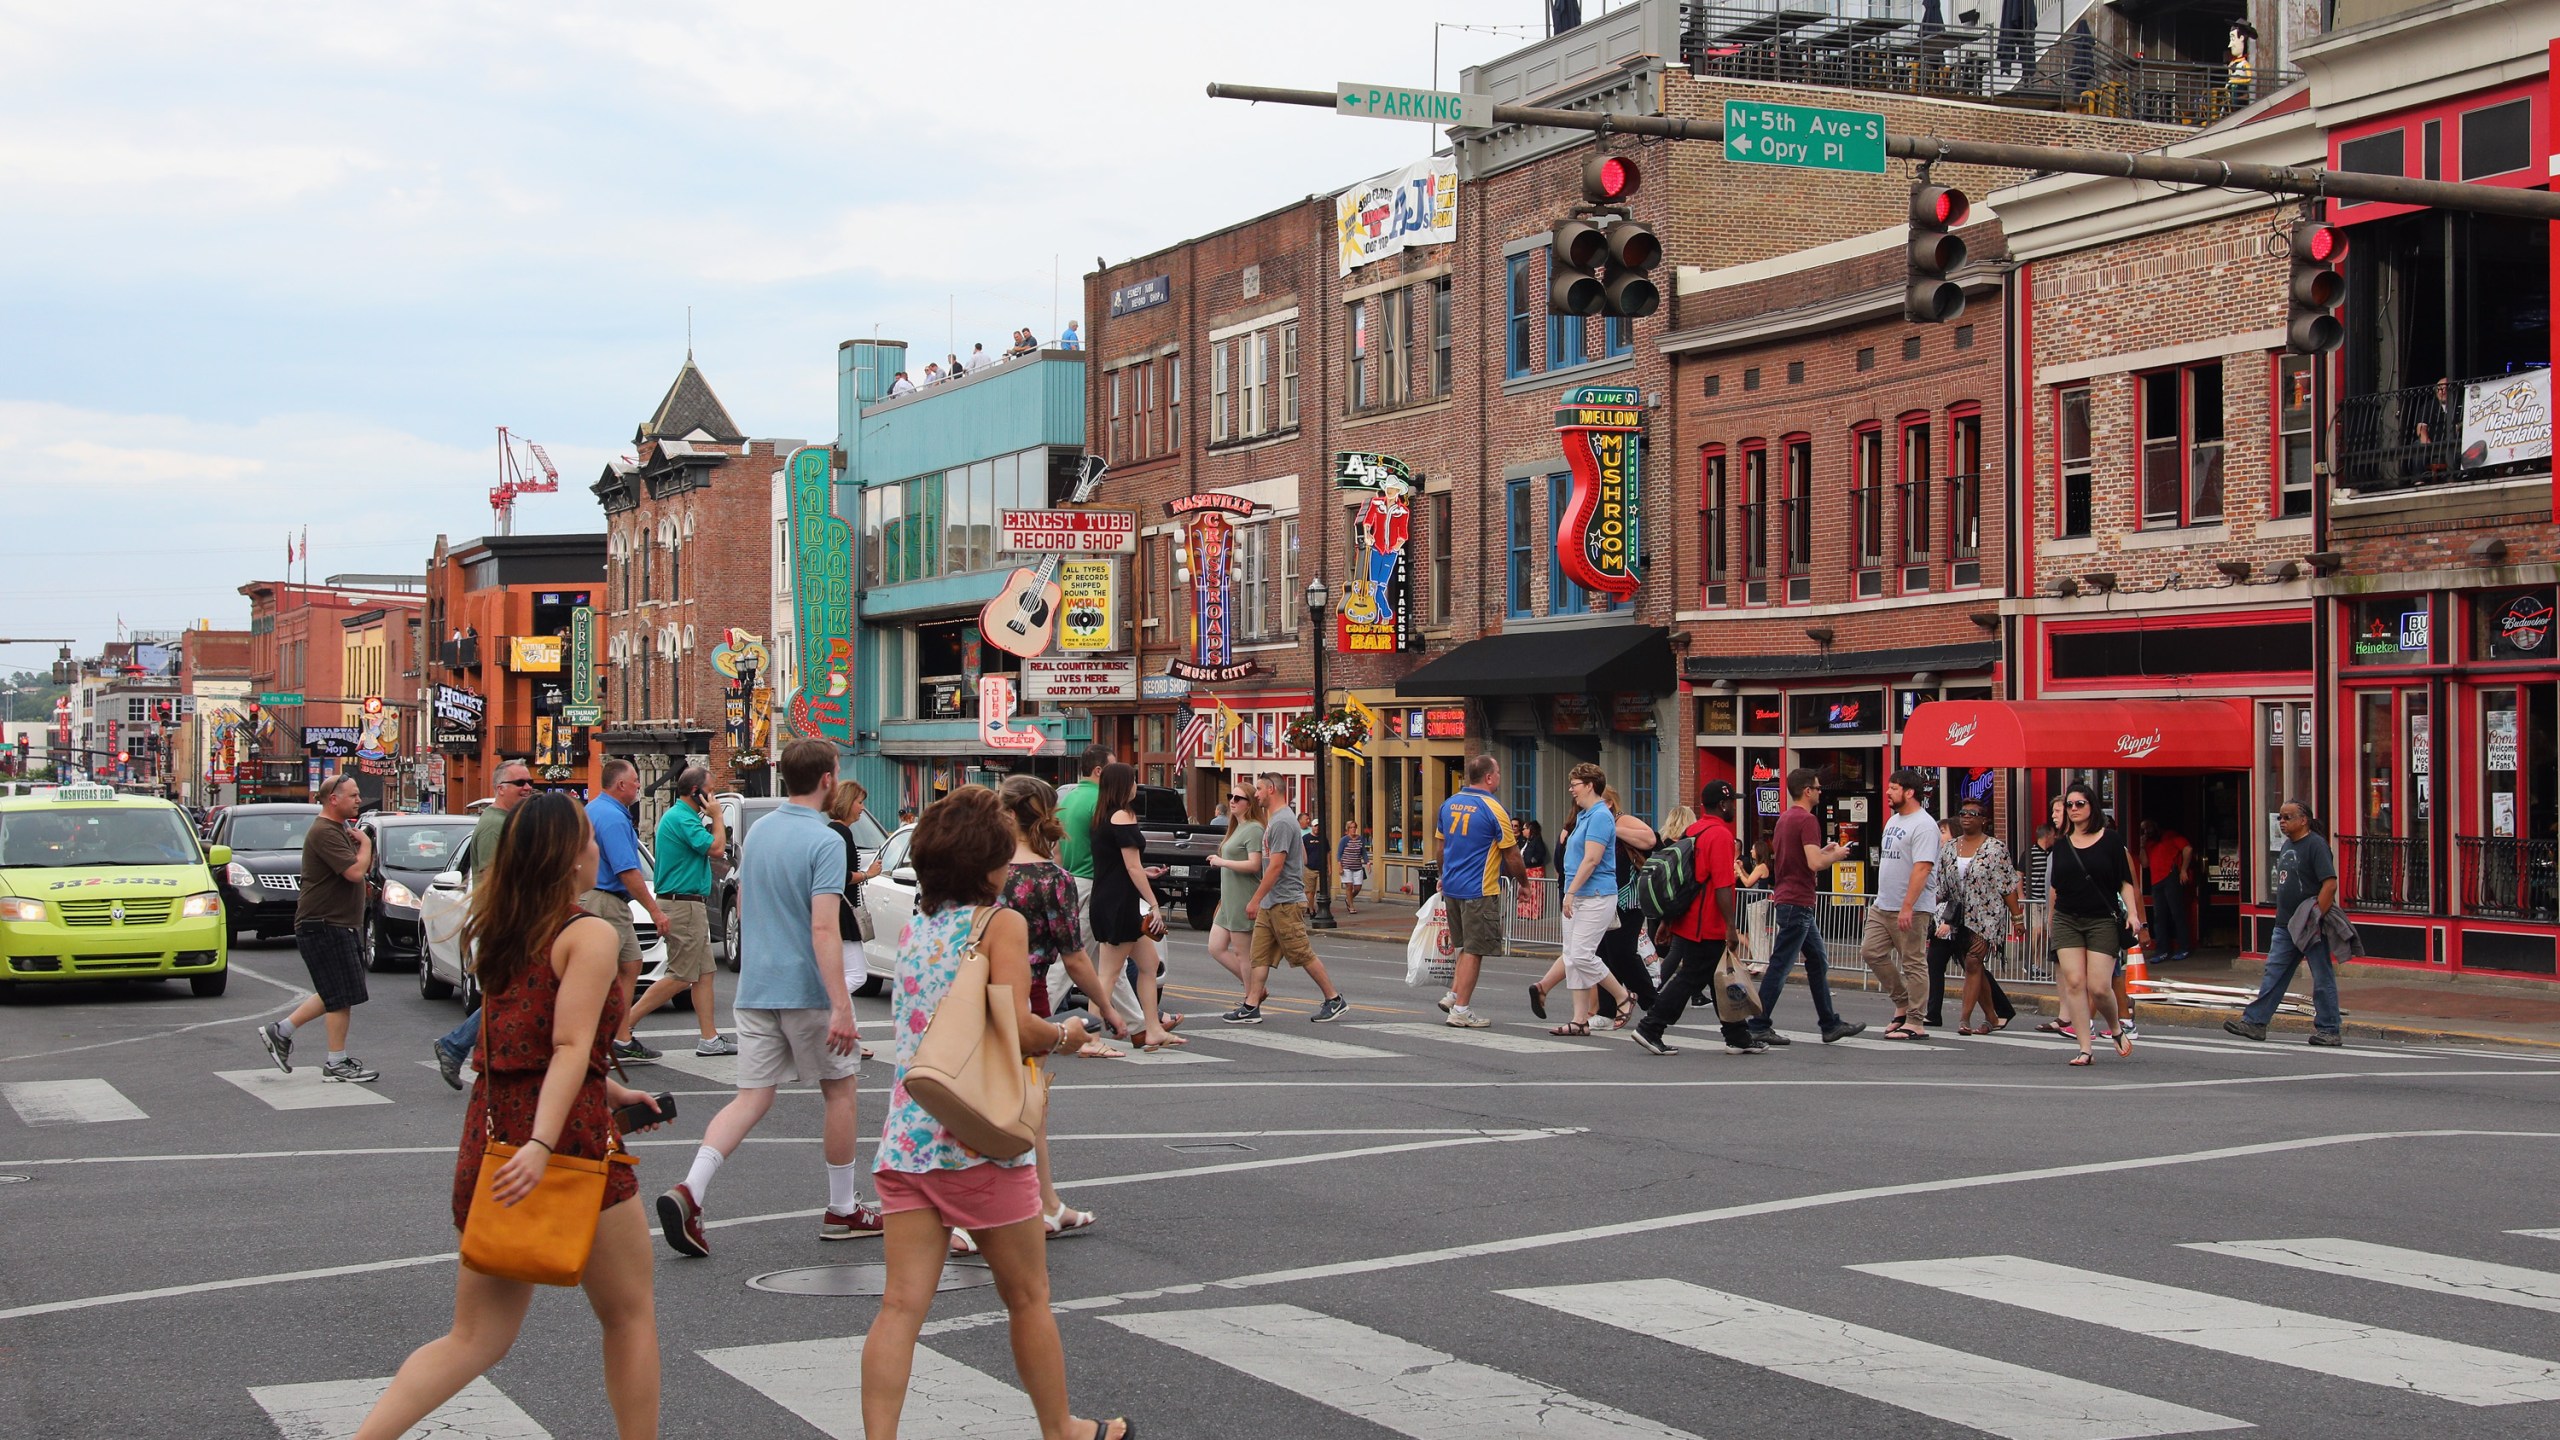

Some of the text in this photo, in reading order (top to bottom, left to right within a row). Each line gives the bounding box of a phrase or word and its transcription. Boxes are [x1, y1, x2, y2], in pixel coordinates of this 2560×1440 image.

[1369, 90, 1461, 120] PARKING
[1731, 109, 1879, 140] N-5th Ave-S
[1760, 136, 1843, 163] Opry Pl
[1598, 393, 1622, 403] LIVE
[1579, 409, 1638, 426] MELLOW
[2485, 404, 2545, 432] Nashville
[2489, 423, 2551, 449] Predators
[1170, 493, 1253, 515] NASHVILLE
[1602, 434, 1623, 569] MUSHROOM
[1004, 511, 1131, 530] ERNEST TUBB
[1014, 532, 1123, 550] RECORD SHOP
[802, 454, 827, 695] PARADISE
[827, 523, 847, 635] PARK
[1075, 573, 1109, 581] RECORDS
[1204, 513, 1223, 665] CROSSROADS
[1066, 598, 1105, 608] WORLD
[1397, 548, 1406, 649] ALAN JACKSON
[2409, 615, 2428, 631] BU
[1350, 634, 1392, 650] BAR
[2355, 641, 2400, 654] Heineken
[540, 650, 560, 663] US
[577, 612, 587, 700] MERCHANTS
[1030, 662, 1128, 670] REAL COUNTRY MUSIC
[1055, 674, 1108, 682] LIVES HERE
[1047, 686, 1066, 694] OUR
[1069, 686, 1091, 694] 70TH
[1142, 679, 1187, 694] RECORD SHOP
[440, 685, 483, 712] HONKY
[435, 701, 472, 725] TONK
[727, 708, 743, 716] US
[1711, 712, 1730, 720] Music
[1710, 722, 1731, 731] Spirits
[1945, 714, 1977, 741] Rippy's
[306, 732, 360, 744] BREWHOUSE
[438, 734, 477, 742] CENTRAL
[992, 736, 1035, 744] TICKETS
[2114, 728, 2161, 753] Rippy's
[326, 746, 348, 756] MOJO
[2492, 753, 2515, 763] Hockey
[361, 766, 396, 775] BOOTS
[2495, 761, 2511, 770] Fans
[60, 789, 113, 800] NASHVEGAS CAB
[1761, 790, 1779, 801] BUD
[1450, 803, 1478, 812] OLD PEZ
[1449, 812, 1471, 836] 71
[50, 878, 177, 890] 332-3333
[1840, 873, 1856, 882] US
